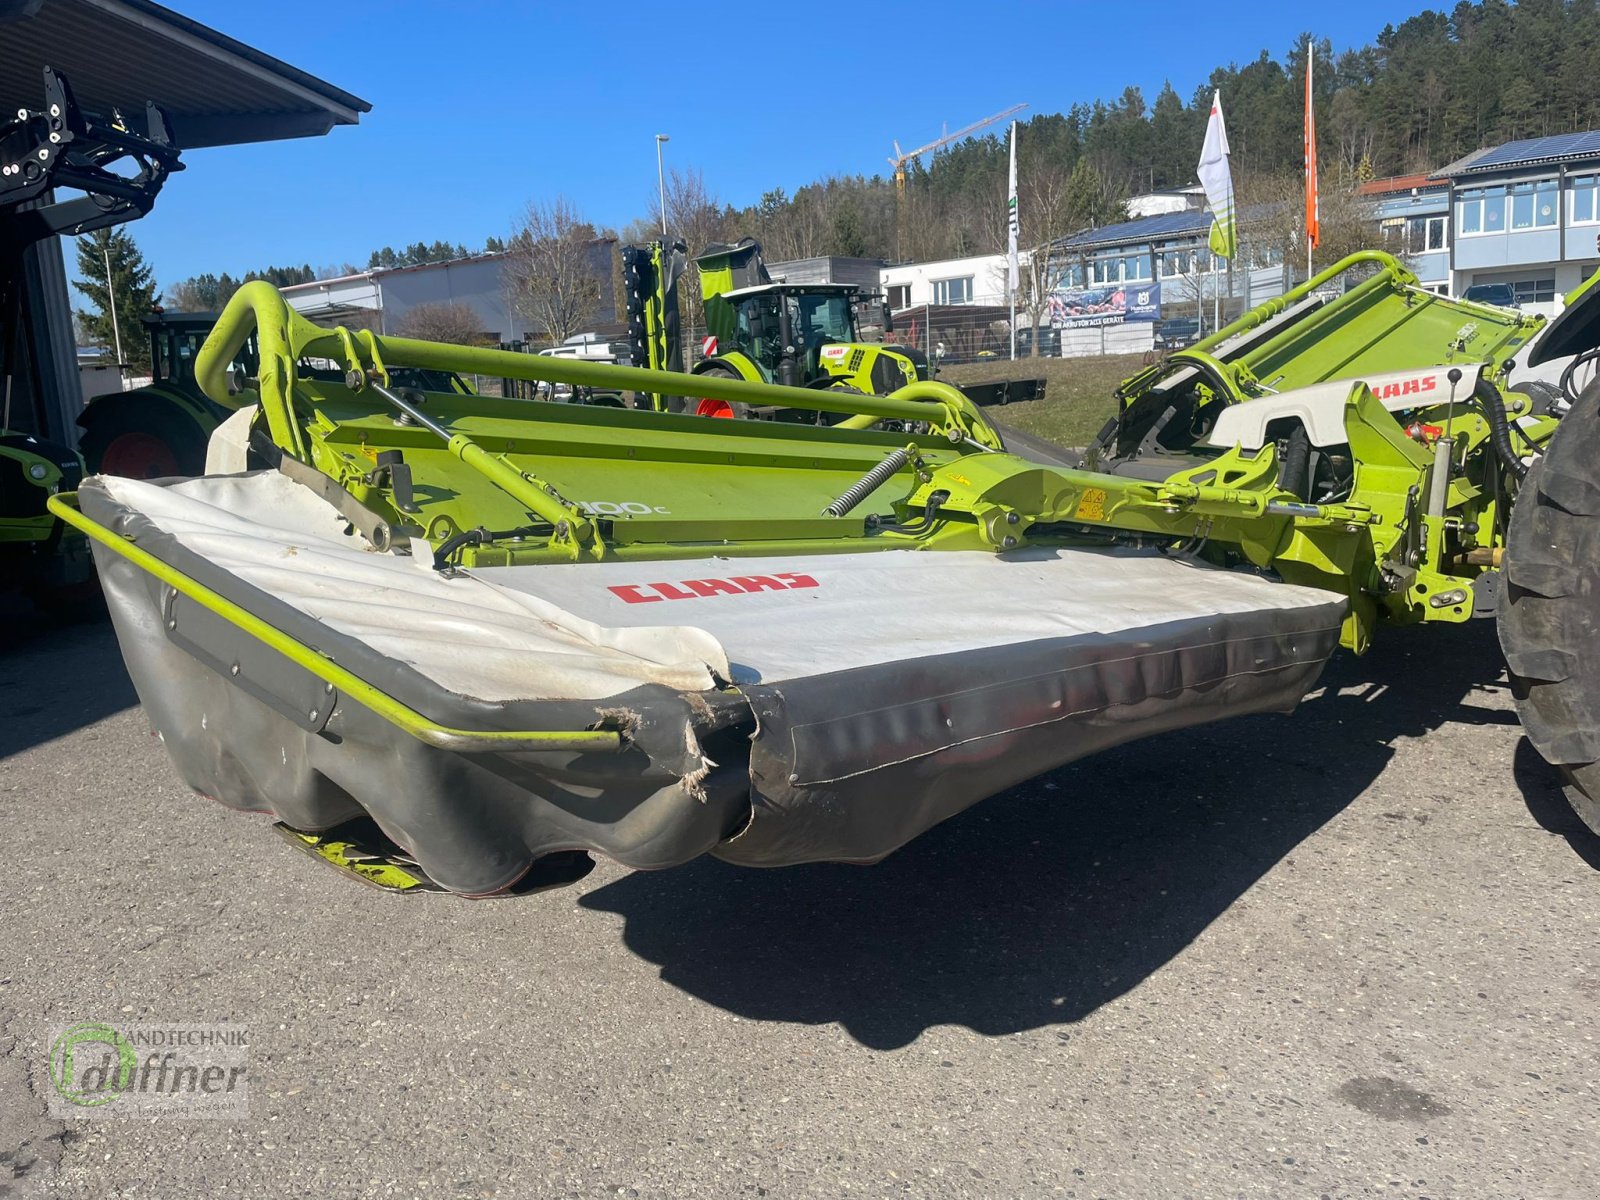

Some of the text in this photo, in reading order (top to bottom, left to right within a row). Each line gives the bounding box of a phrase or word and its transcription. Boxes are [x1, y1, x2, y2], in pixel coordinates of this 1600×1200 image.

[1103, 316, 1124, 325] GERÄTE
[827, 348, 843, 356] CLAAS
[1371, 376, 1436, 400] LAAS
[607, 572, 820, 604] CLAAS
